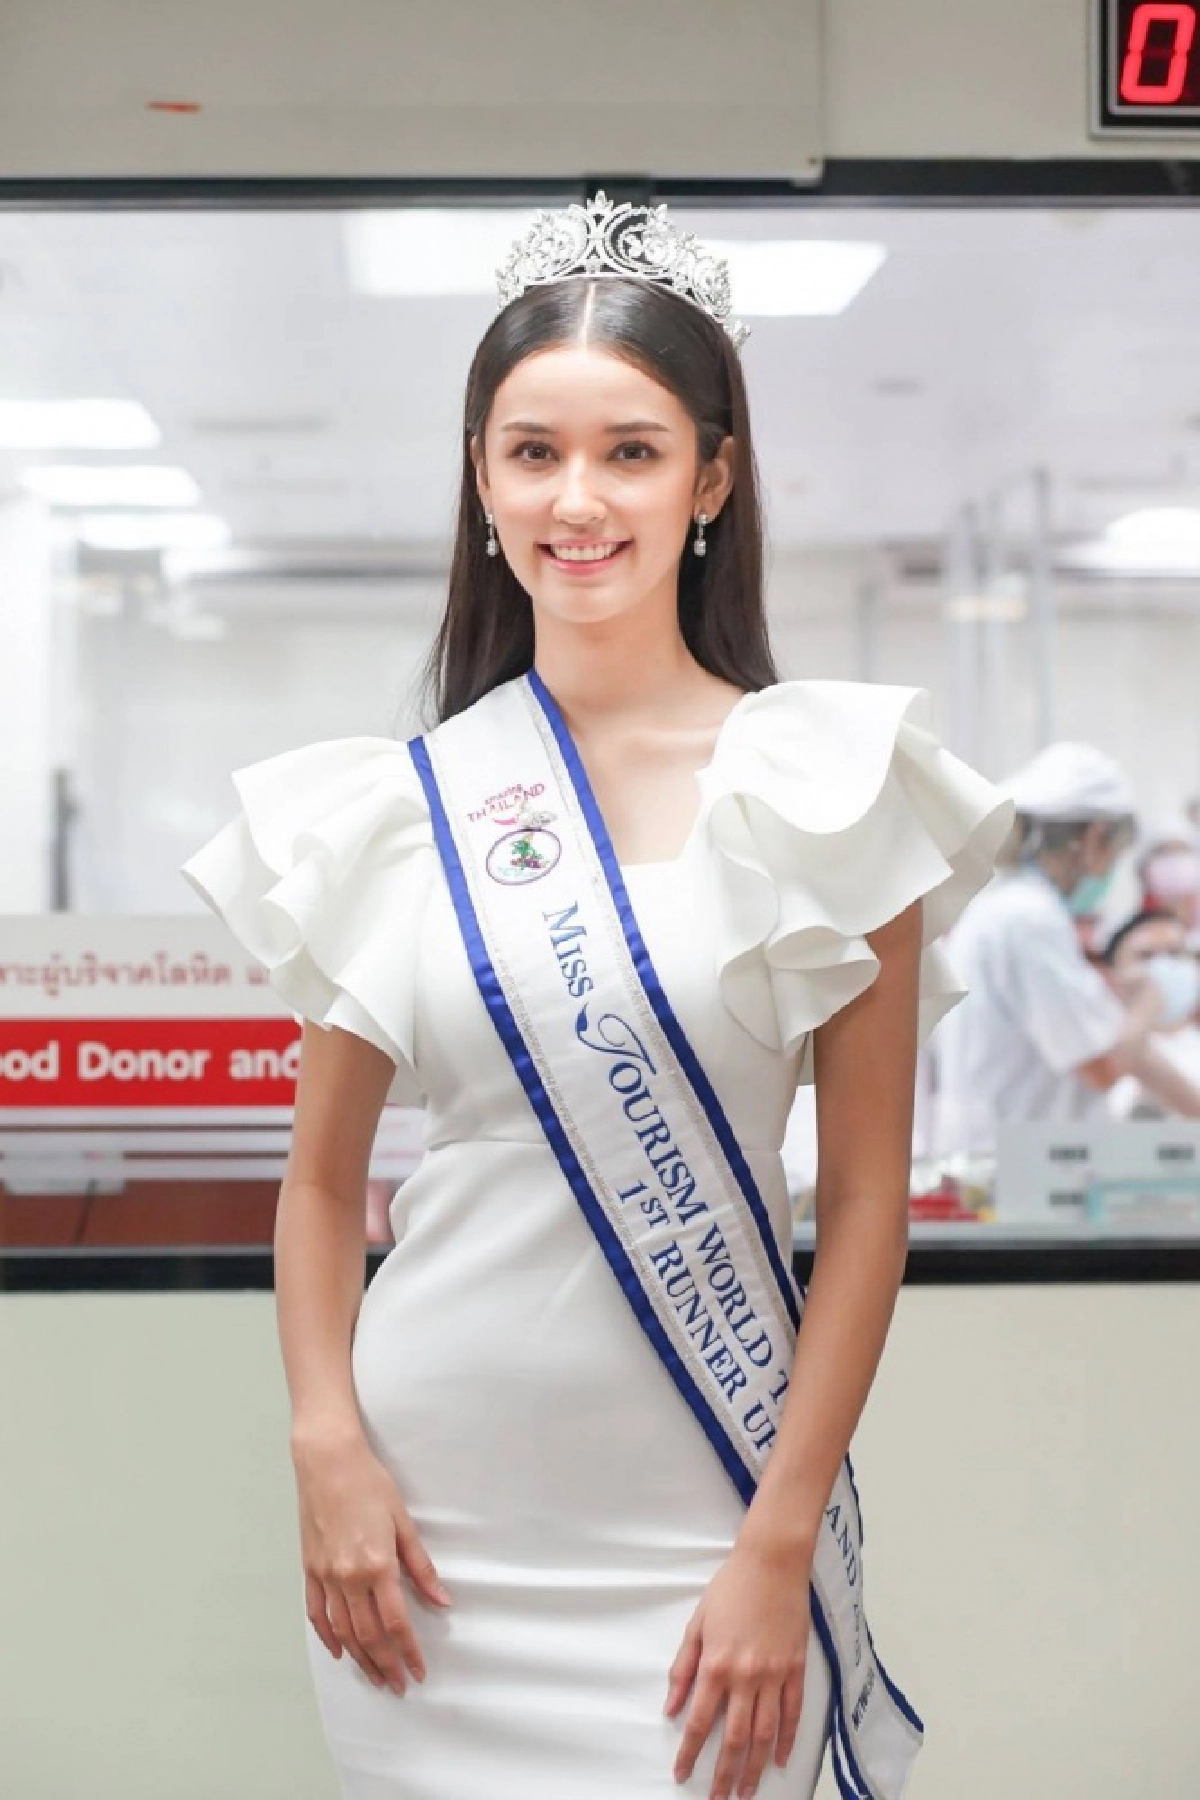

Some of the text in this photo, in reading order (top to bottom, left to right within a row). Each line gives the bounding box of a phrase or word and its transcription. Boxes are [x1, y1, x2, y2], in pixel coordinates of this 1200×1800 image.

[1120, 3, 1196, 103] 0
[467, 782, 546, 823] THAILAND
[0, 1039, 60, 1082] od
[77, 1040, 211, 1082] Donor
[575, 1002, 708, 1226] TOURISM
[697, 1221, 773, 1368] WORLD
[649, 1239, 746, 1404] RUNNER
